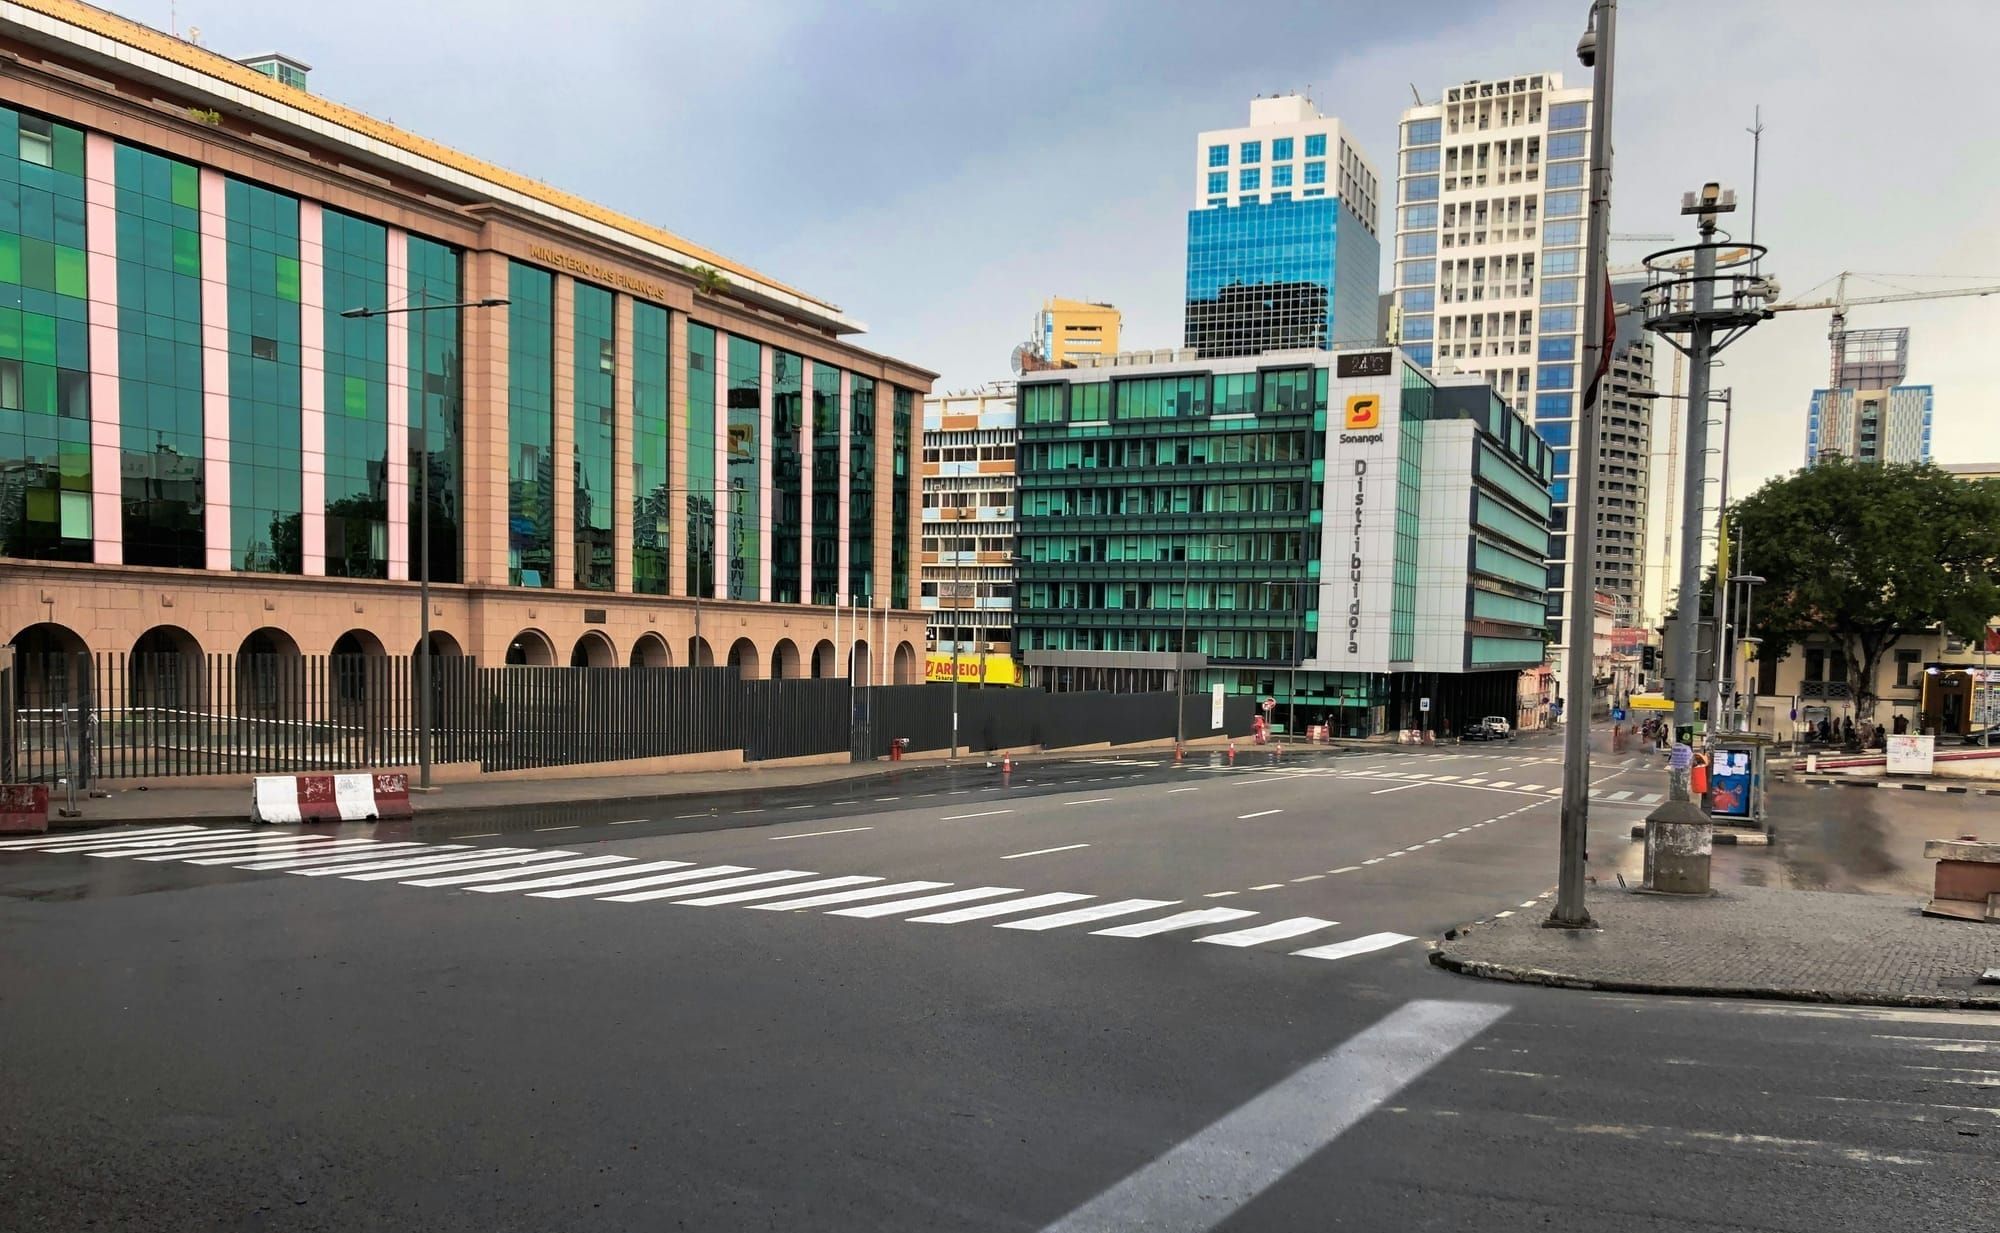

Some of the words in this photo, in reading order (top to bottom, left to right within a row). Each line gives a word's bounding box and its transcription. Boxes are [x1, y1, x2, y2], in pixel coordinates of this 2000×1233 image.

[592, 266, 614, 282] DAS
[1340, 433, 1383, 445] Sonangol
[1348, 459, 1367, 654] Distribuidora
